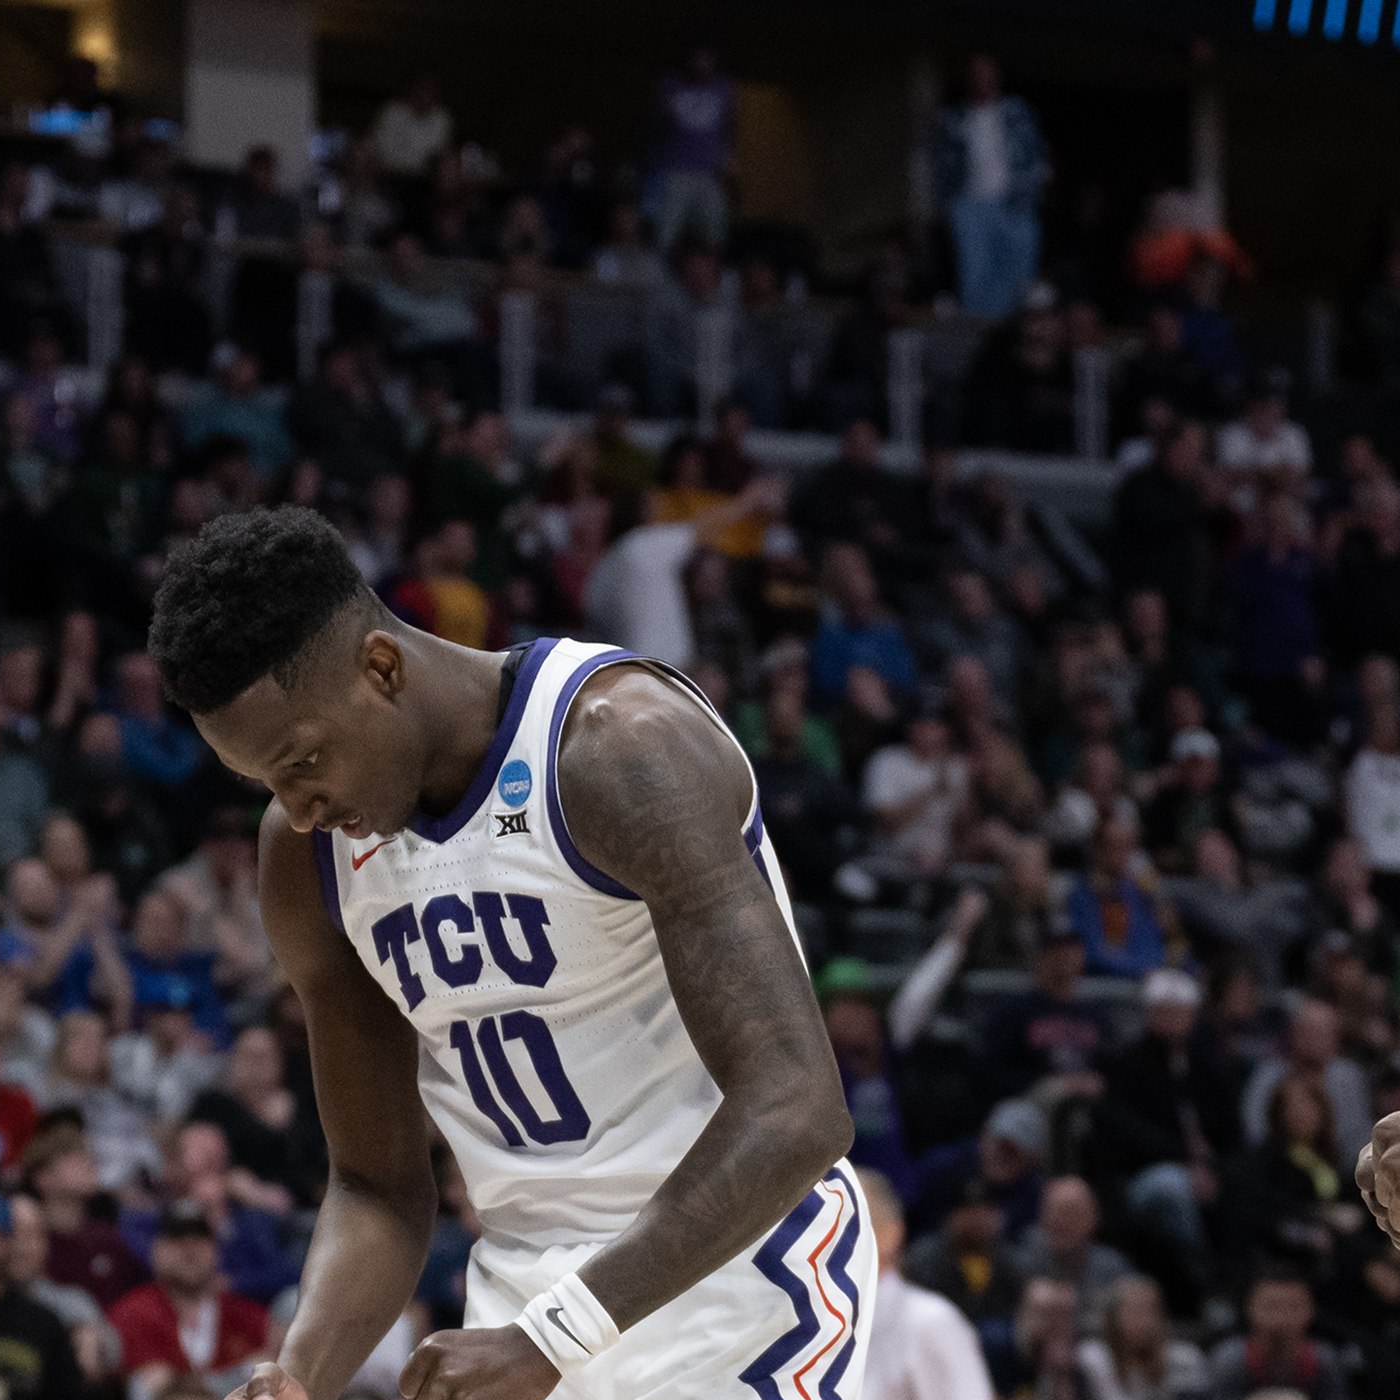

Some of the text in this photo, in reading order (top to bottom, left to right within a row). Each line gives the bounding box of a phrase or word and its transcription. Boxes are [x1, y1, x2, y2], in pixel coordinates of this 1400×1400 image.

[493, 809, 532, 838] XII
[370, 890, 560, 1014] TCU
[448, 1009, 593, 1148] 10
